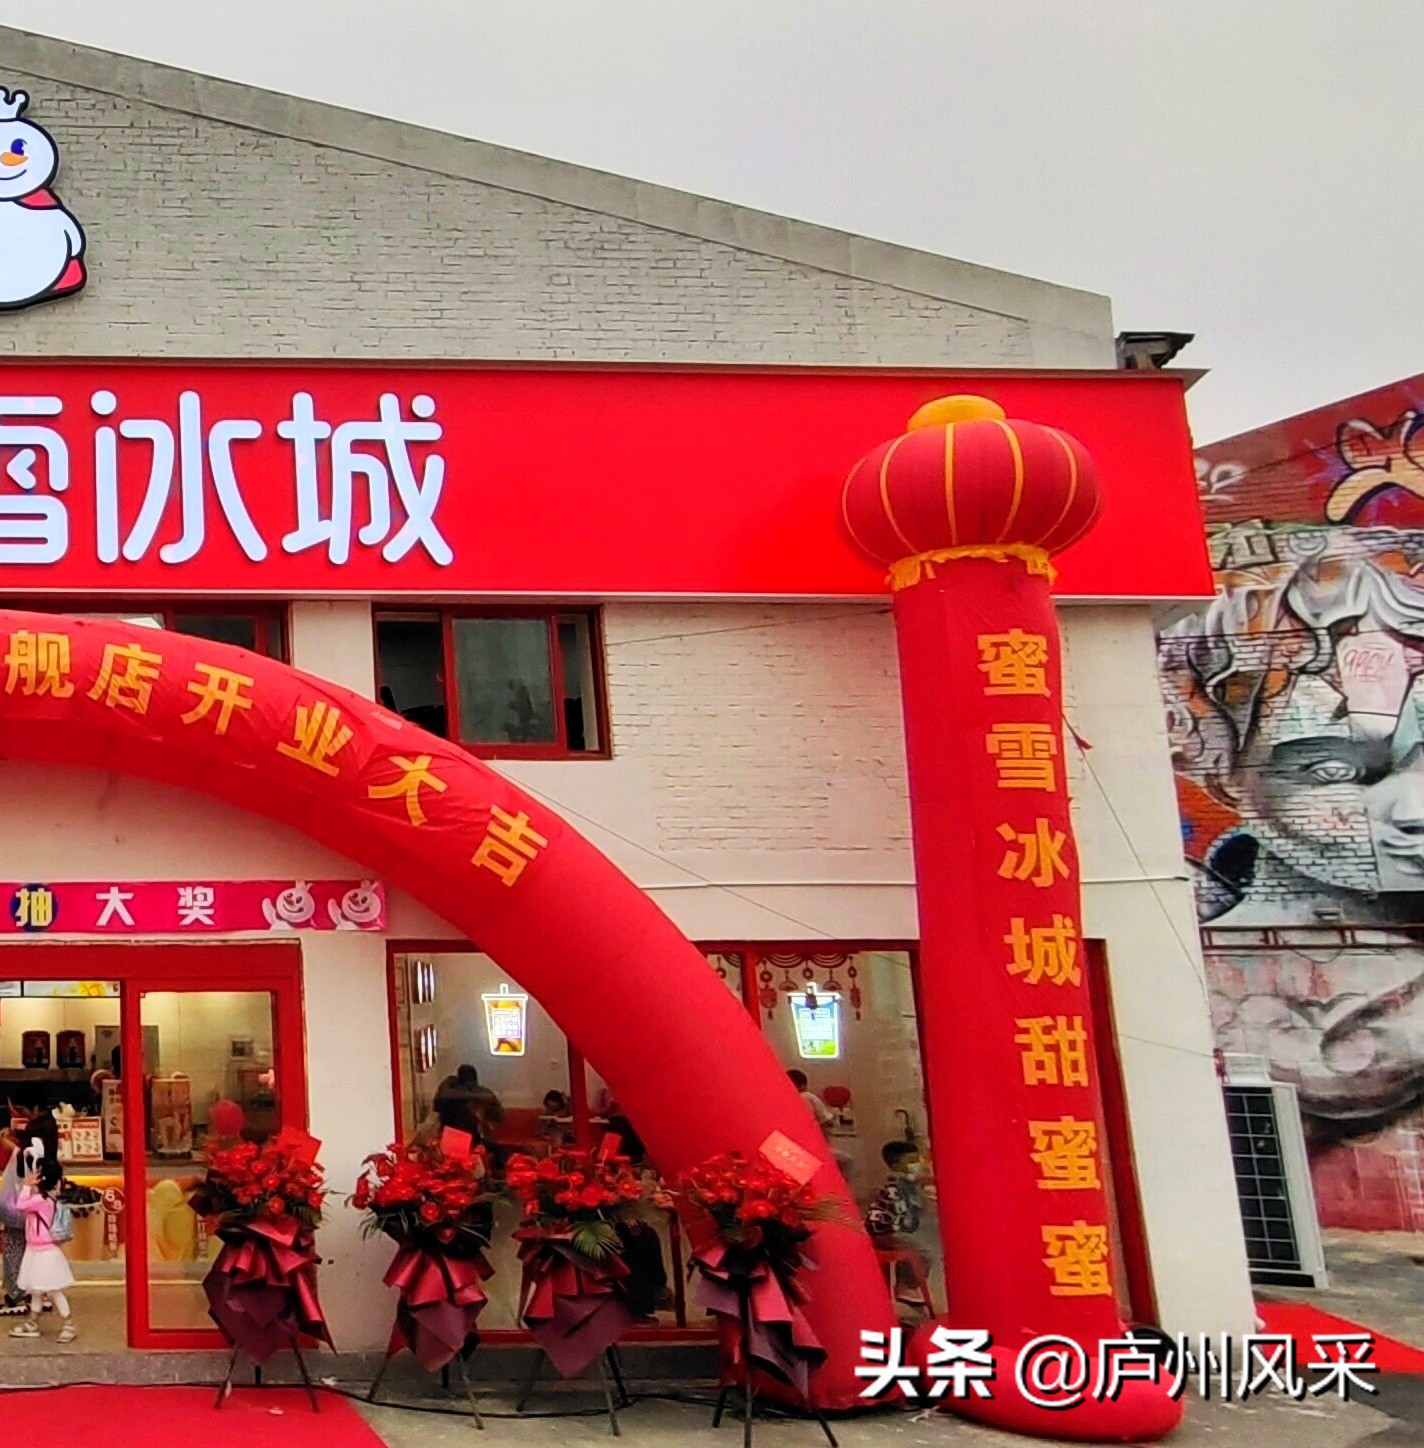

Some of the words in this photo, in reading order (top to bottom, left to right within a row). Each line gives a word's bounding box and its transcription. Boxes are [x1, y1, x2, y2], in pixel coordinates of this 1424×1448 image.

[977, 627, 1112, 1298] 蜜雪冰城甜蜜蜜
